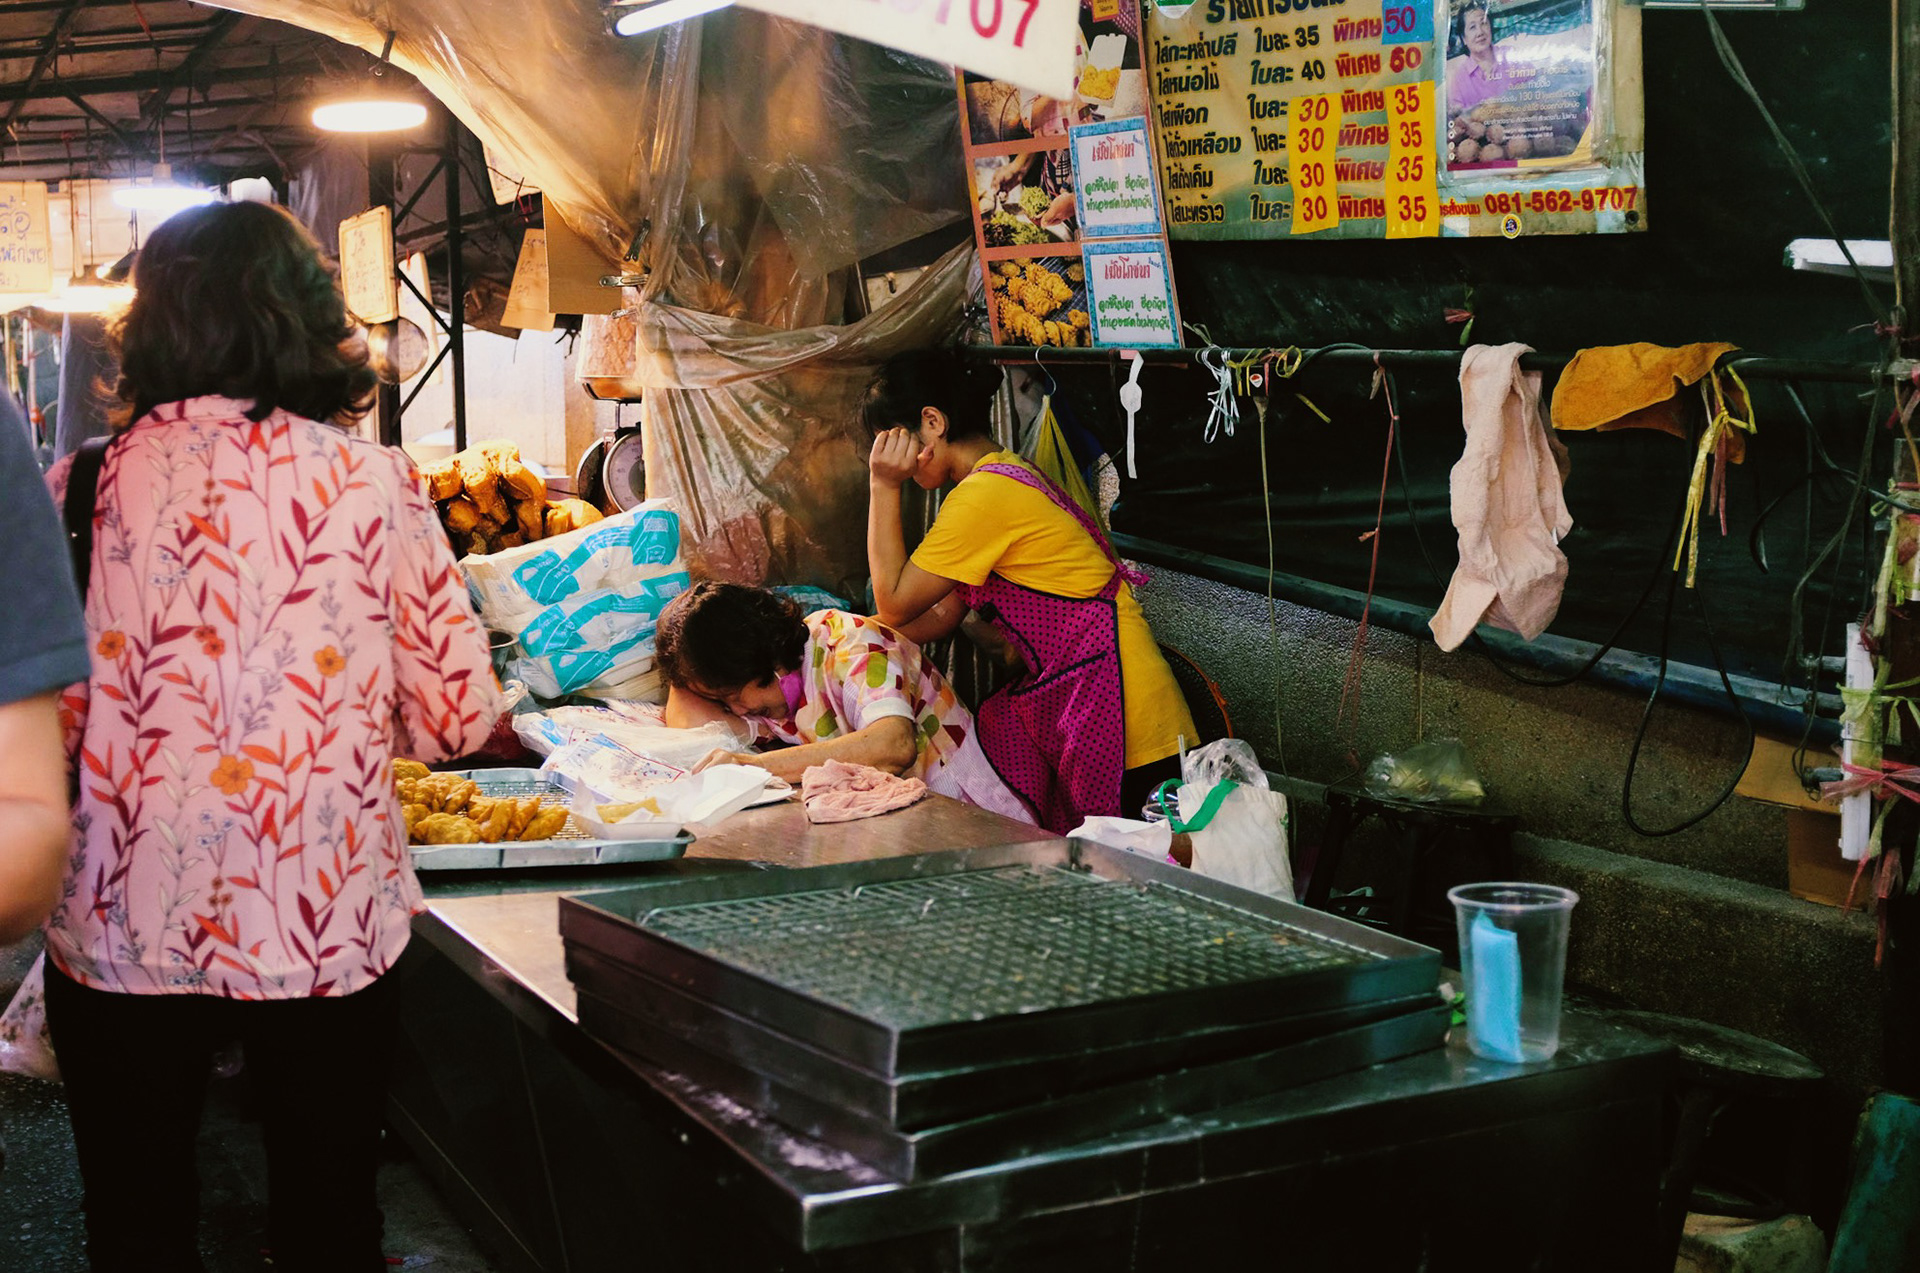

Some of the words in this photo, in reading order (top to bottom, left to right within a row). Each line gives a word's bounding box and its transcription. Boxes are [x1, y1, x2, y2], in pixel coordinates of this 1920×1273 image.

[1254, 27, 1291, 53] ใบละ
[1295, 25, 1320, 48] 35
[1333, 18, 1382, 43] พิเศษ
[1385, 6, 1416, 35] 50
[1250, 60, 1294, 85] ใบละ
[1301, 59, 1326, 81] 40
[1335, 53, 1381, 77] พิเศษ
[1247, 93, 1288, 120] ใบละ
[1298, 97, 1329, 122] 30
[1341, 89, 1385, 113] พิเศษ
[1394, 85, 1420, 115] 35
[1251, 126, 1287, 152] ใบละ
[1298, 127, 1324, 153] 30
[1338, 124, 1390, 147] พิเศษ
[1400, 121, 1422, 148] 35
[1253, 159, 1289, 185] ใบละ
[1300, 162, 1324, 188] 30
[1334, 158, 1386, 182] พิเศษ
[1396, 155, 1424, 182] 35
[1250, 194, 1292, 221] ใบละ
[1302, 195, 1327, 222] 30
[1337, 195, 1386, 218] พิเศษ
[1398, 195, 1427, 222] 35
[1484, 186, 1638, 215] 081-562-9707
